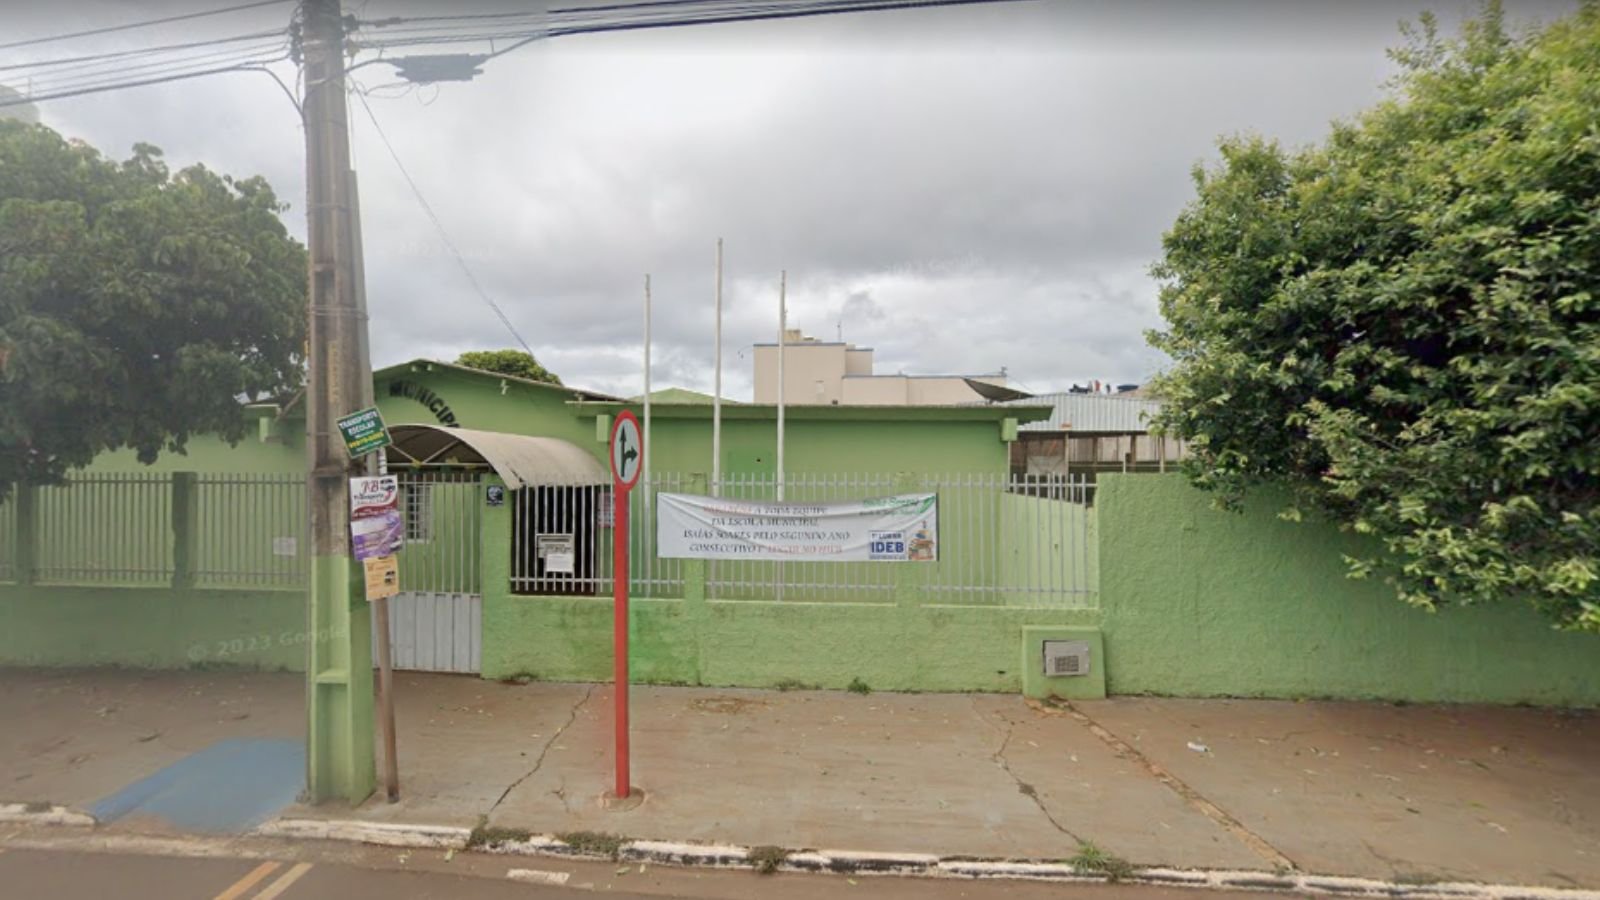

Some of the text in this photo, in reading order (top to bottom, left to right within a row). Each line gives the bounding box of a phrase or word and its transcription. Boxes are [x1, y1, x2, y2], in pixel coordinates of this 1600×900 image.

[389, 380, 460, 428] MUNICIP
[348, 420, 375, 437] ESCOLAR
[728, 517, 764, 526] ESCOLA
[767, 517, 818, 526] MUNICIPAL
[753, 531, 778, 540] PELO
[780, 531, 826, 541] SEGUNDO
[828, 531, 851, 540] ANO
[871, 541, 904, 553] IDEB
